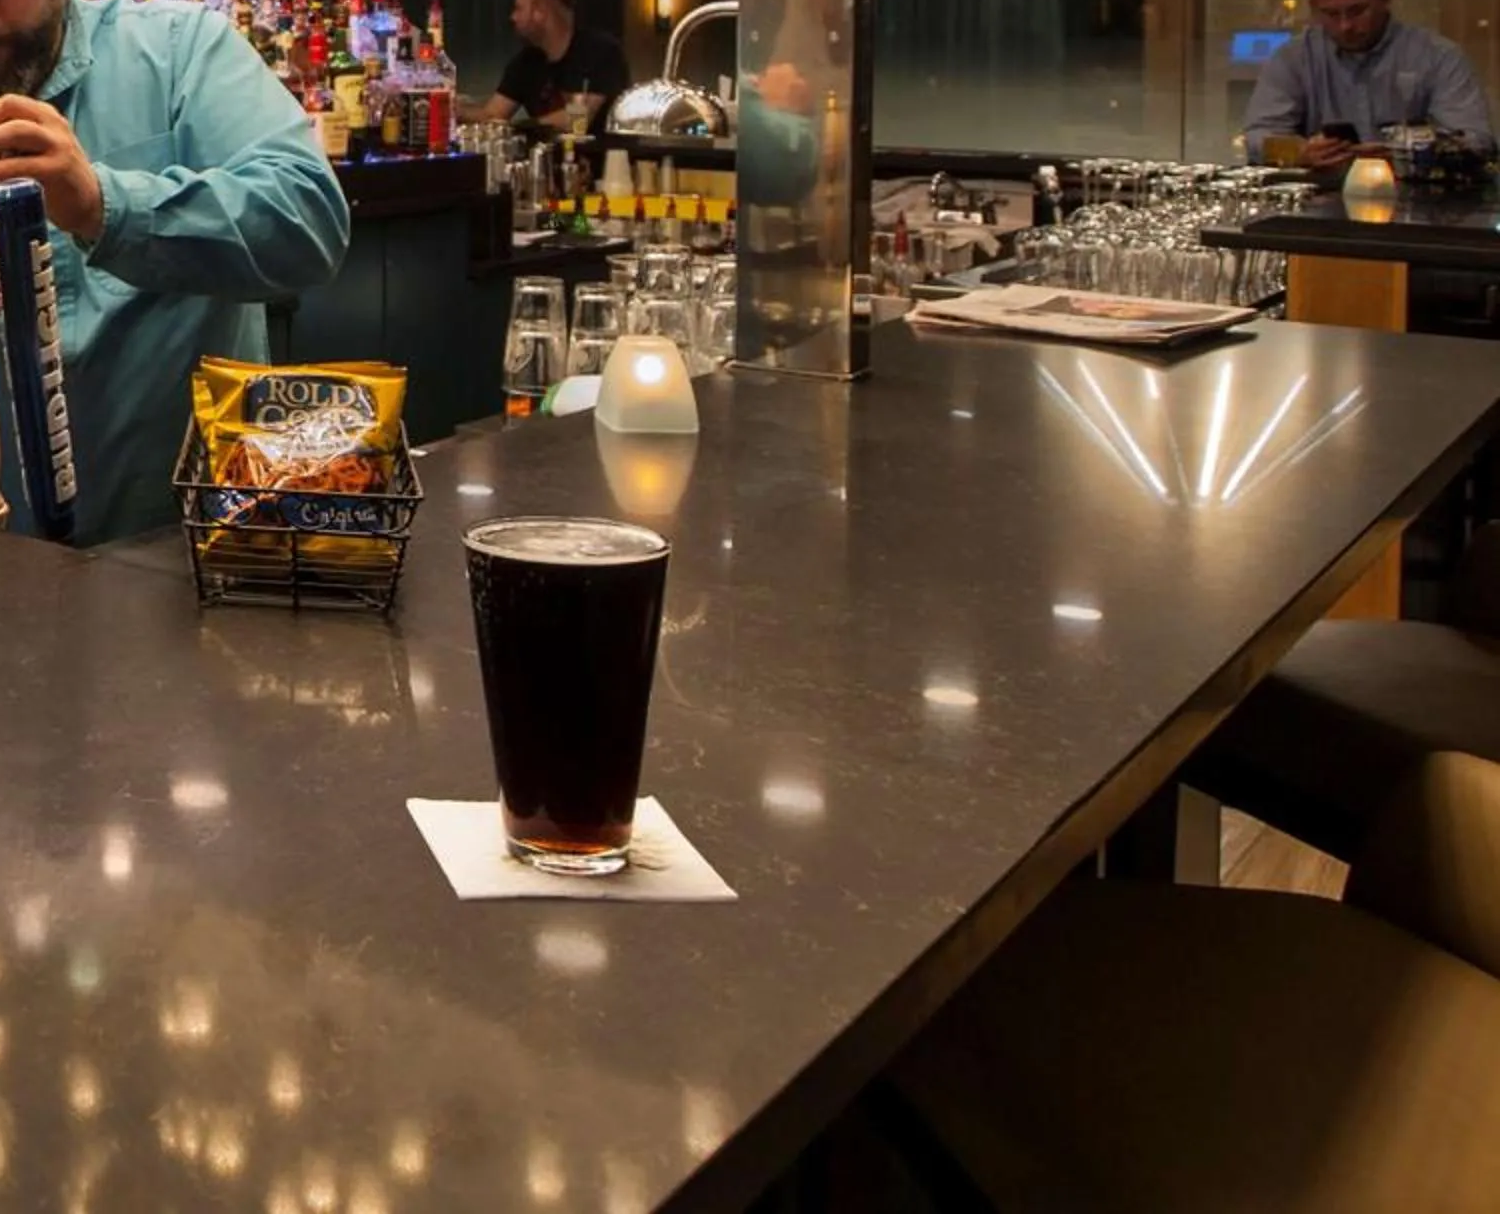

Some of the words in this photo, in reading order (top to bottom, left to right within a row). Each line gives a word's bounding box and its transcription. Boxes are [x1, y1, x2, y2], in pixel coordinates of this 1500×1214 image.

[29, 239, 65, 390] LIGHT
[46, 392, 78, 504] BUD
[267, 377, 357, 409] ROLD
